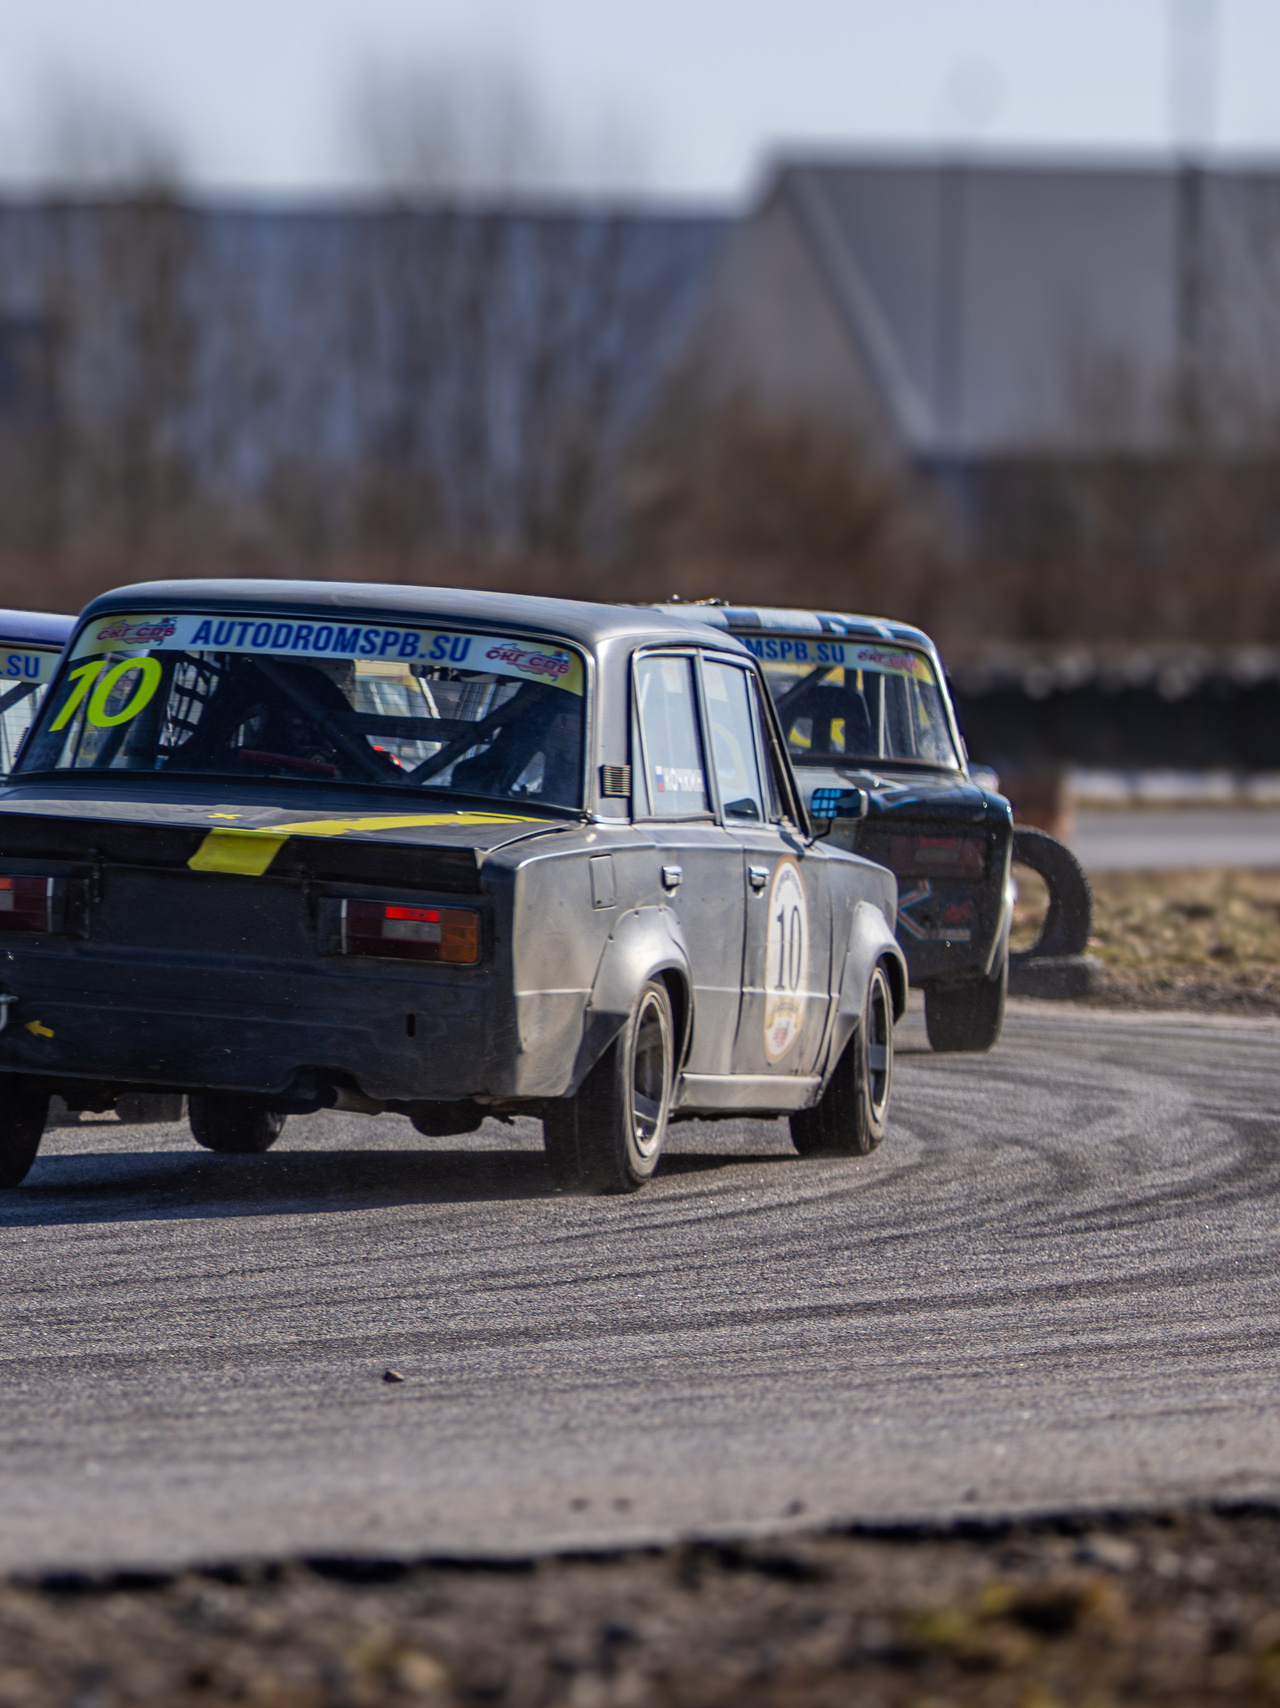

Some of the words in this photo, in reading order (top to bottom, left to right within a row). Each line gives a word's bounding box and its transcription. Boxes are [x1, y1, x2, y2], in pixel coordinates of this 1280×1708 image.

[190, 619, 472, 663] AUTODROMSPB.SU
[738, 637, 845, 664] MSPB.SU
[48, 656, 162, 732] 10
[774, 904, 802, 993] 10
